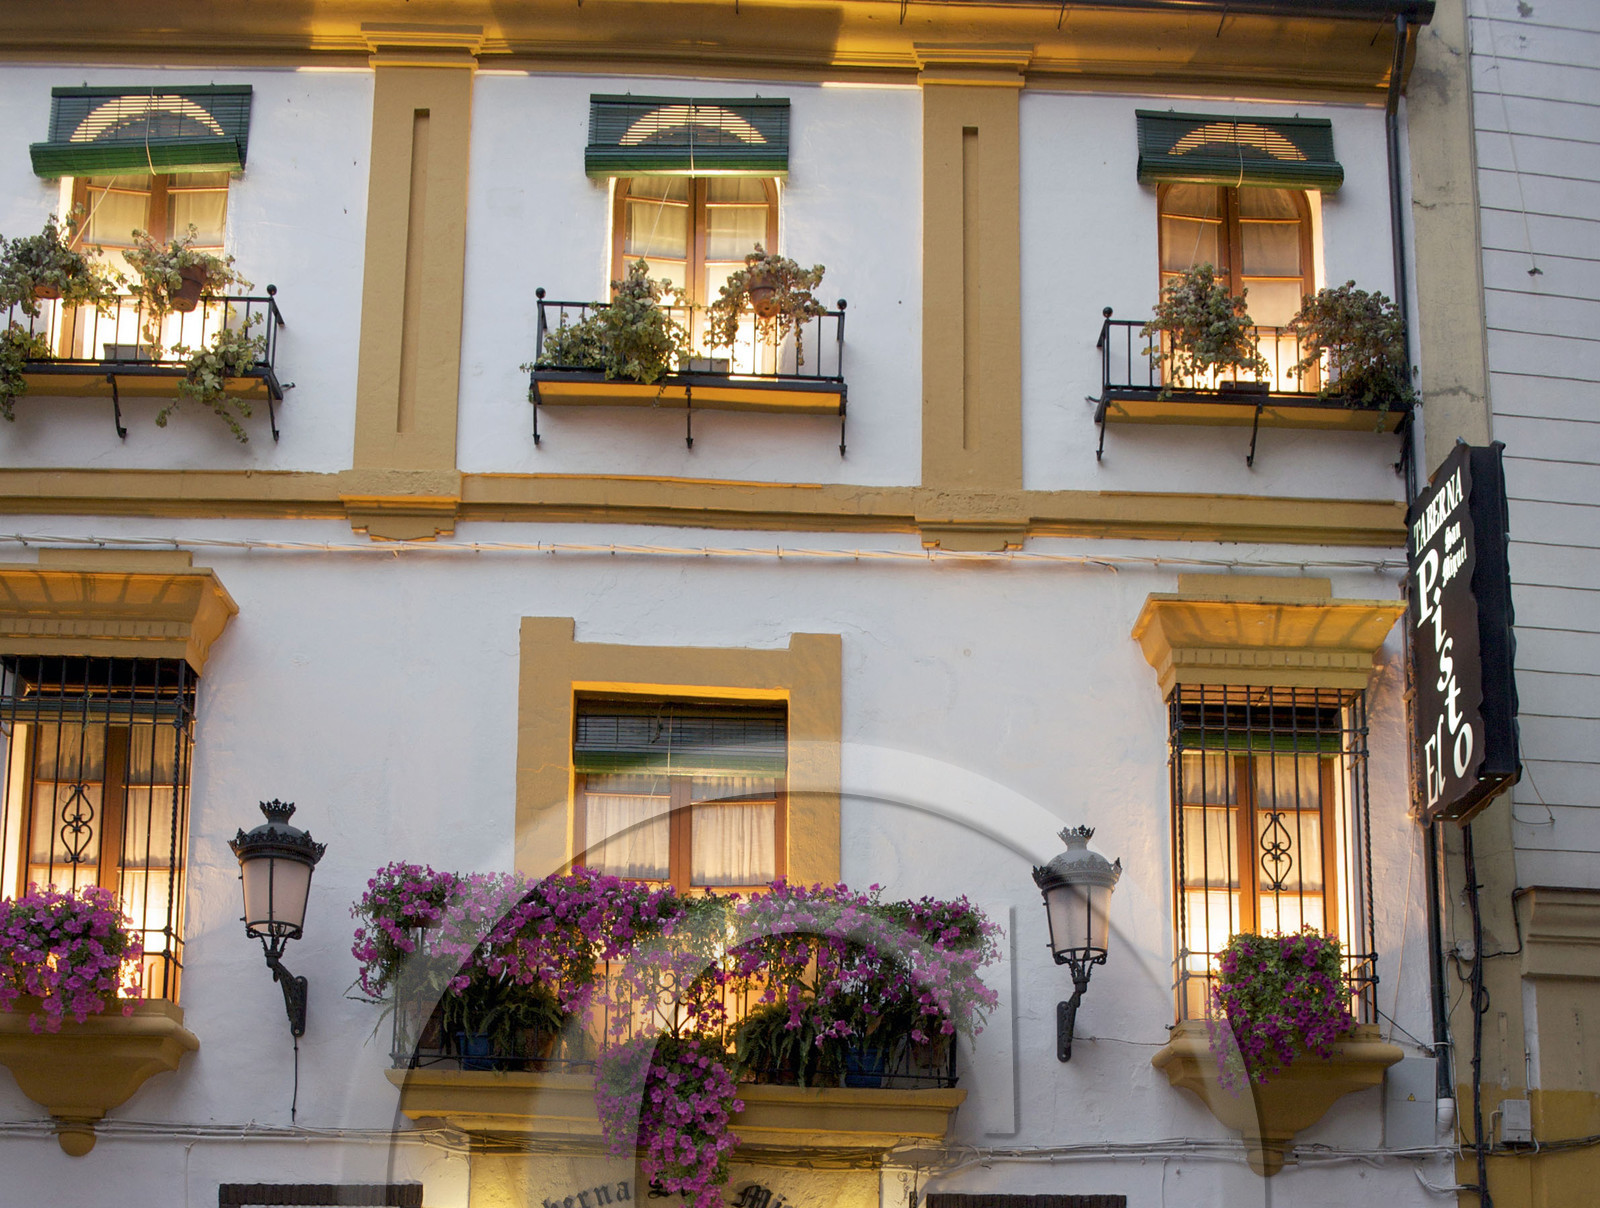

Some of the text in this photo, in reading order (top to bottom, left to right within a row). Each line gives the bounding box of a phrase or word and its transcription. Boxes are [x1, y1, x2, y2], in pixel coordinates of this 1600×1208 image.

[1413, 465, 1464, 558] TABERNA
[1444, 520, 1461, 553] San
[1442, 537, 1467, 587] Miguel
[1416, 548, 1473, 810] El Pisto
